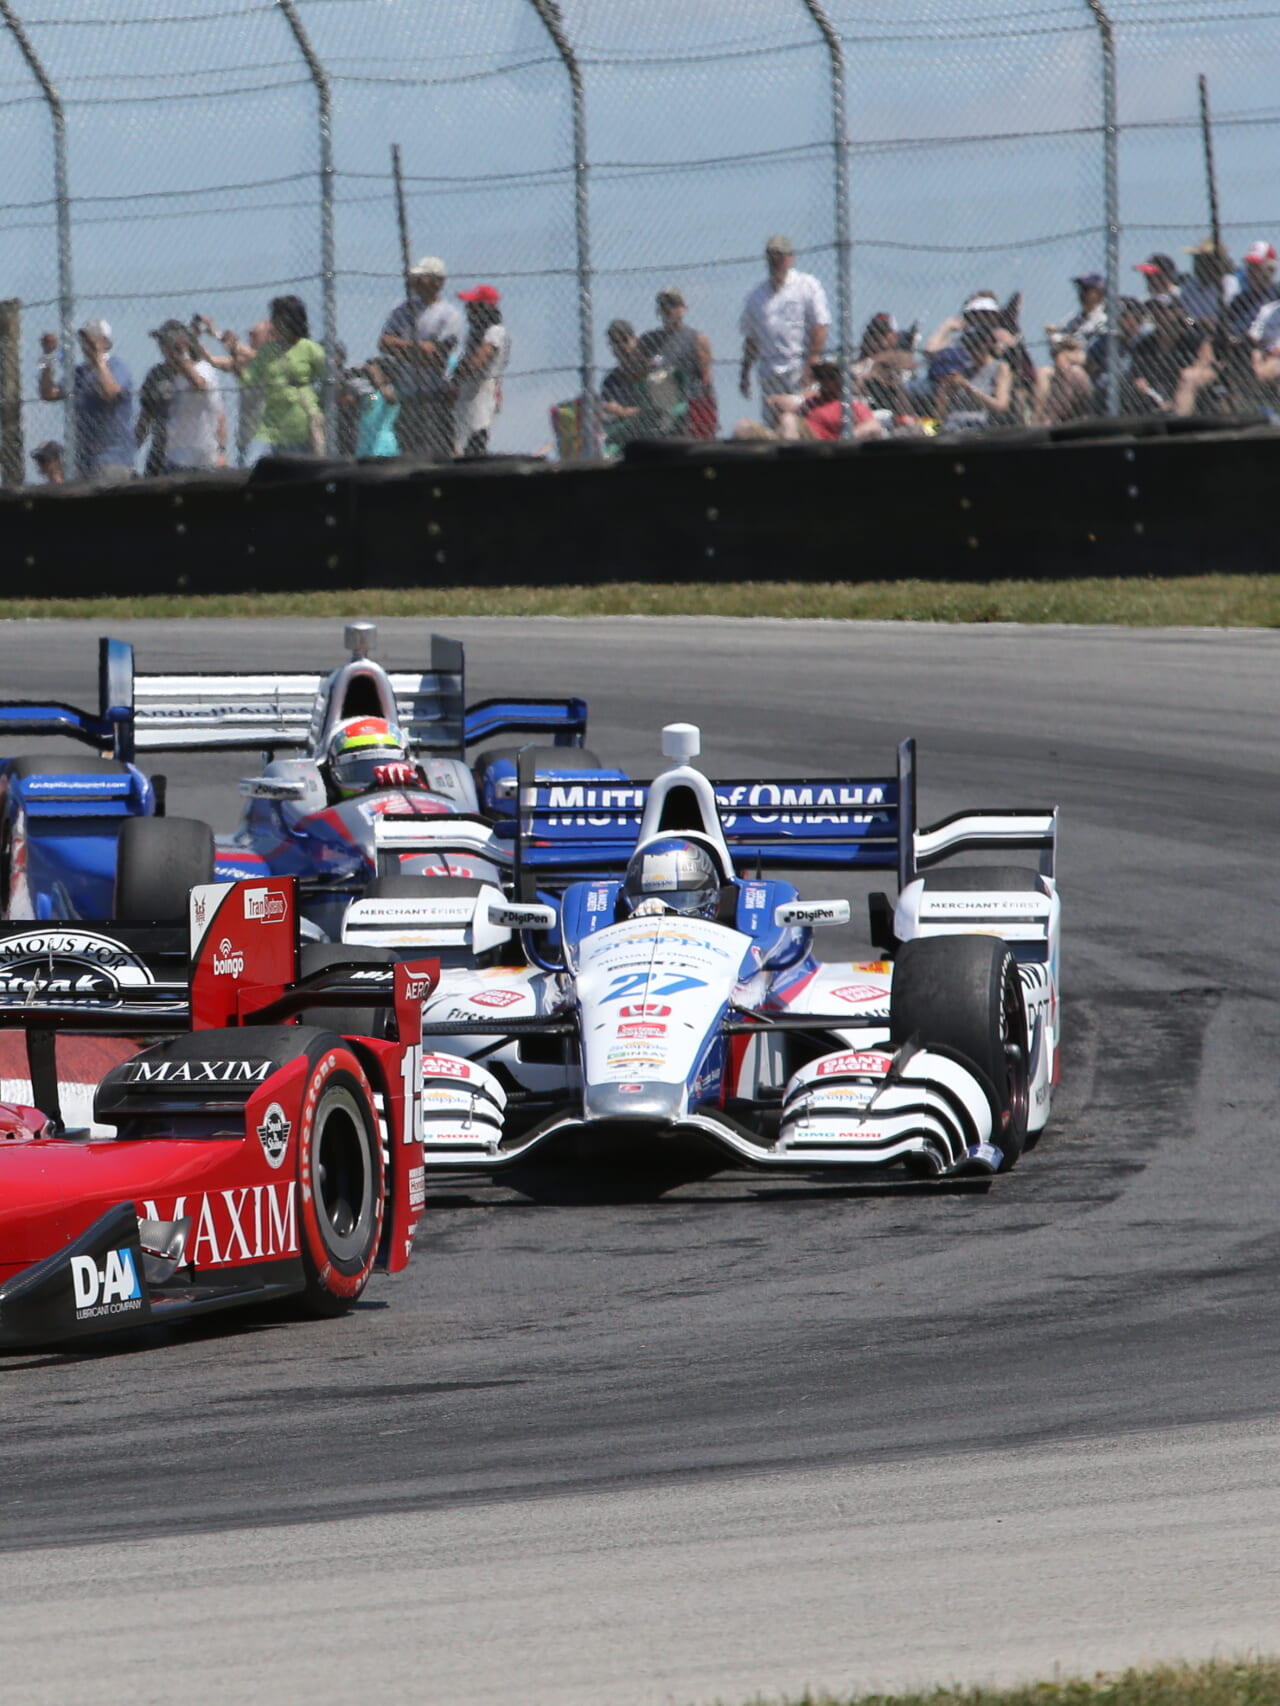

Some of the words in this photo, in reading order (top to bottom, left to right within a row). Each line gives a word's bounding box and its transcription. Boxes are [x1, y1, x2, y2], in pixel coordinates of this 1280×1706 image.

[748, 785, 888, 824] OMAHA
[360, 908, 427, 916] MERCHANT
[796, 908, 834, 922] DigiPen
[930, 902, 999, 910] MERCHANT
[508, 911, 549, 925] DigiPen
[84, 941, 128, 972] FOR
[214, 953, 244, 979] boingo
[598, 972, 709, 1005] 27
[134, 1061, 272, 1081] MAXIM
[823, 1055, 886, 1067] GIANT
[823, 1063, 884, 1073] EAGLE
[300, 1054, 336, 1203] Firestone
[76, 1303, 110, 1320] LUBRICANT
[110, 1299, 143, 1314] COMPANY
